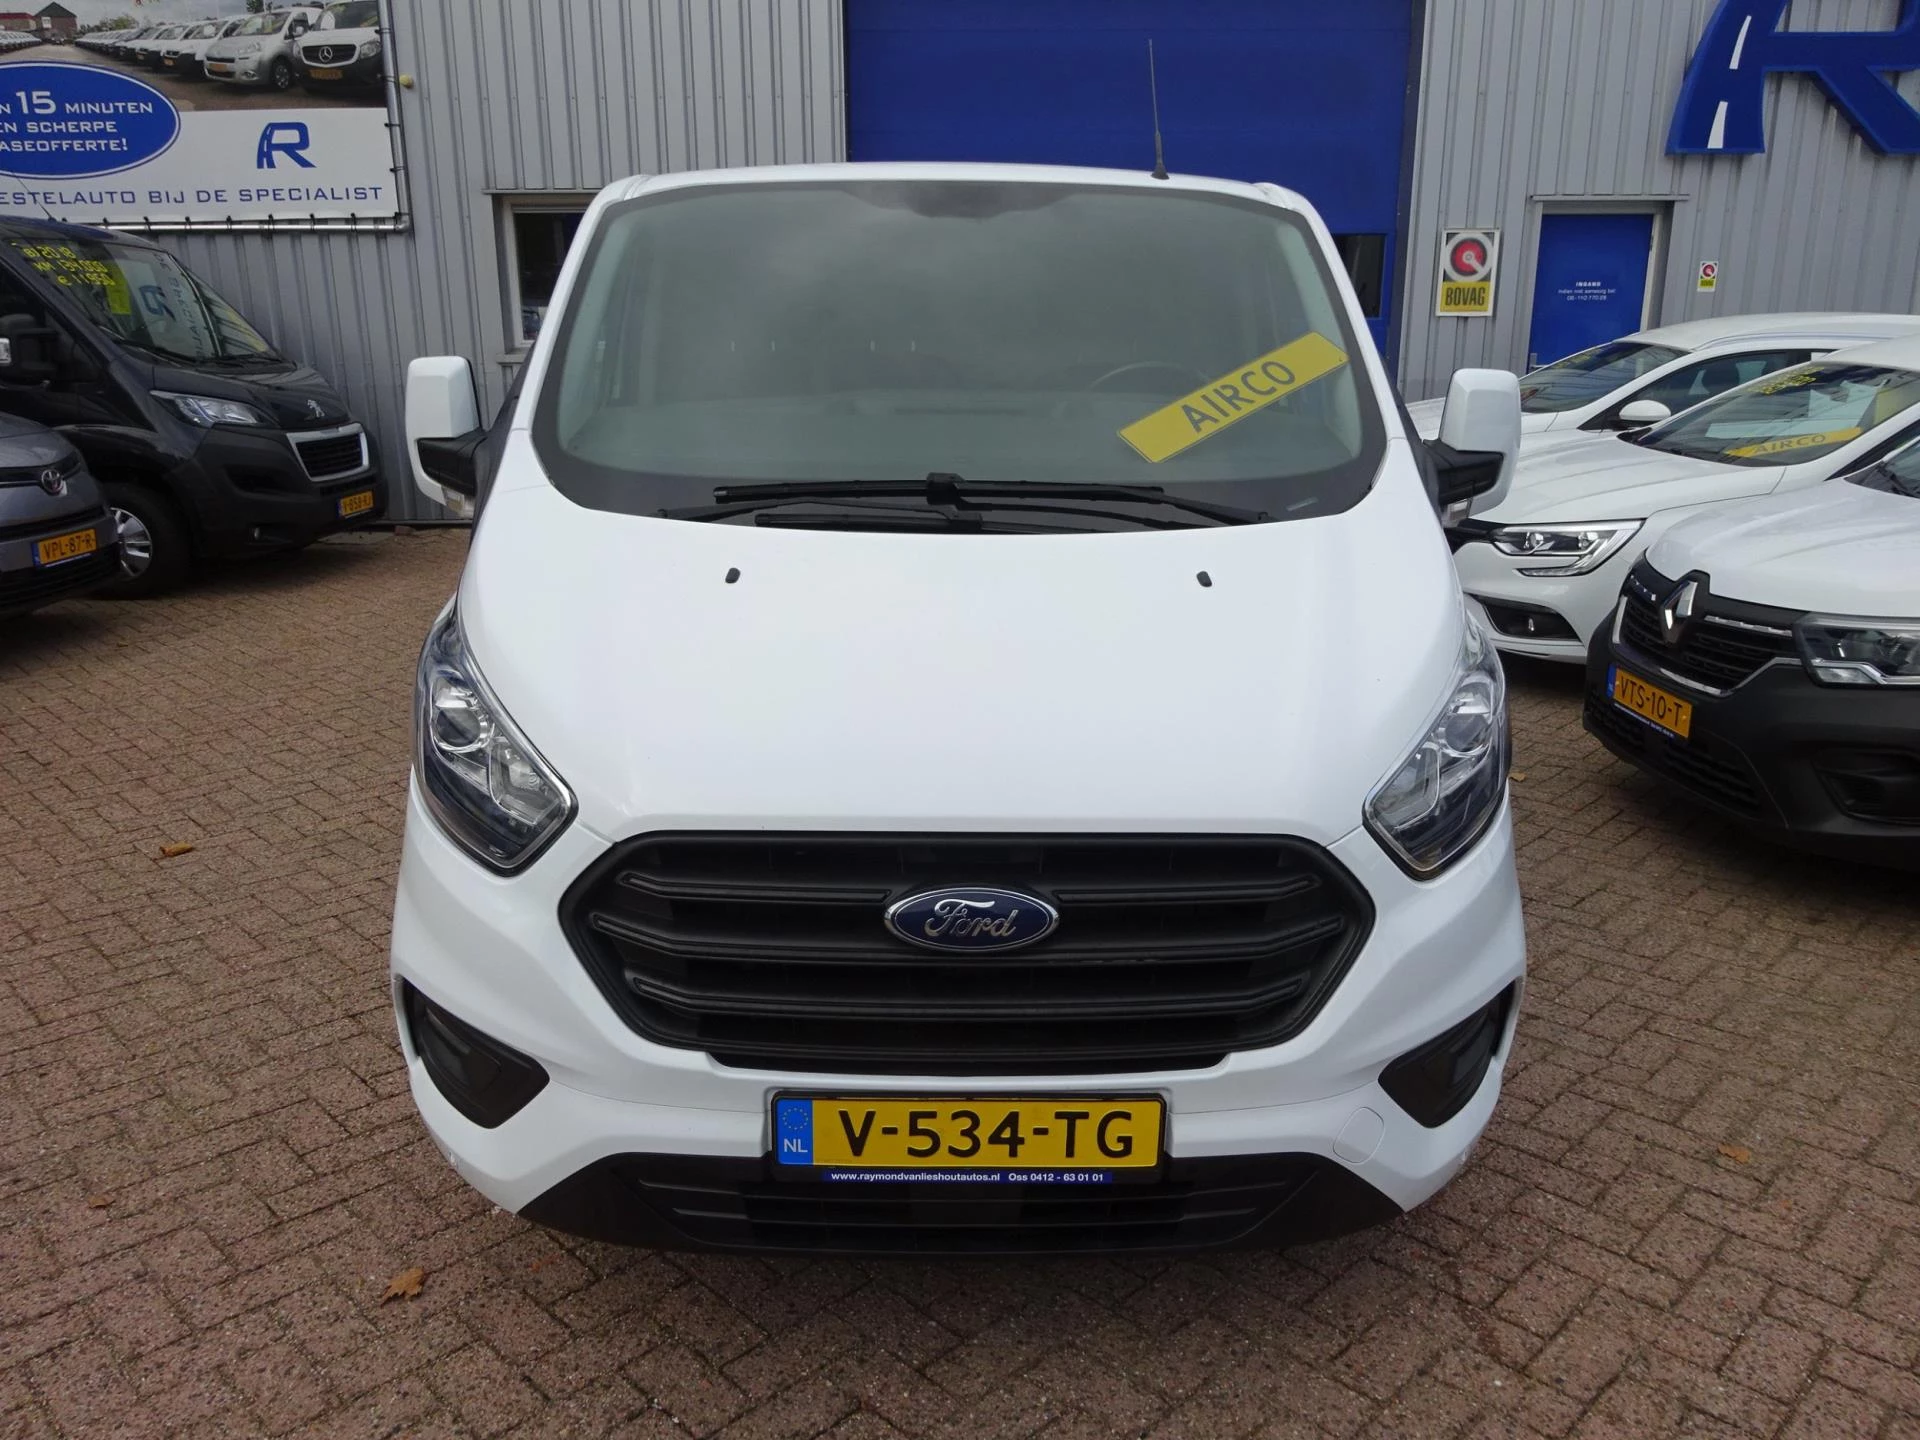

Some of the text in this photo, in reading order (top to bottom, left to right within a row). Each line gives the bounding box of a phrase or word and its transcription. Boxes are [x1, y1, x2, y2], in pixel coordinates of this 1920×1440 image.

[16, 91, 56, 115] 15
[65, 102, 153, 114] MINUTEN
[26, 121, 118, 133] SCHERPE
[0, 138, 129, 152] ASEOFFERTE!
[0, 187, 383, 205] ESTELAUTO BIJ DE SPECIALIST
[1445, 287, 1486, 306] BOVAG
[1181, 360, 1296, 433] AIRCO
[1753, 434, 1826, 453] AIRCO
[1621, 675, 1684, 728] VTS-10-T
[924, 899, 1020, 937] Ford
[838, 1109, 1133, 1158] V-534-TG
[783, 1139, 808, 1153] NL
[831, 1172, 1000, 1182] www.raymondvanlieshoutautos.nl
[1008, 1173, 1028, 1182] Oss
[1030, 1173, 1054, 1182] 0412
[1063, 1173, 1076, 1182] 63
[1078, 1173, 1090, 1182] 01
[1092, 1173, 1104, 1182] 01
